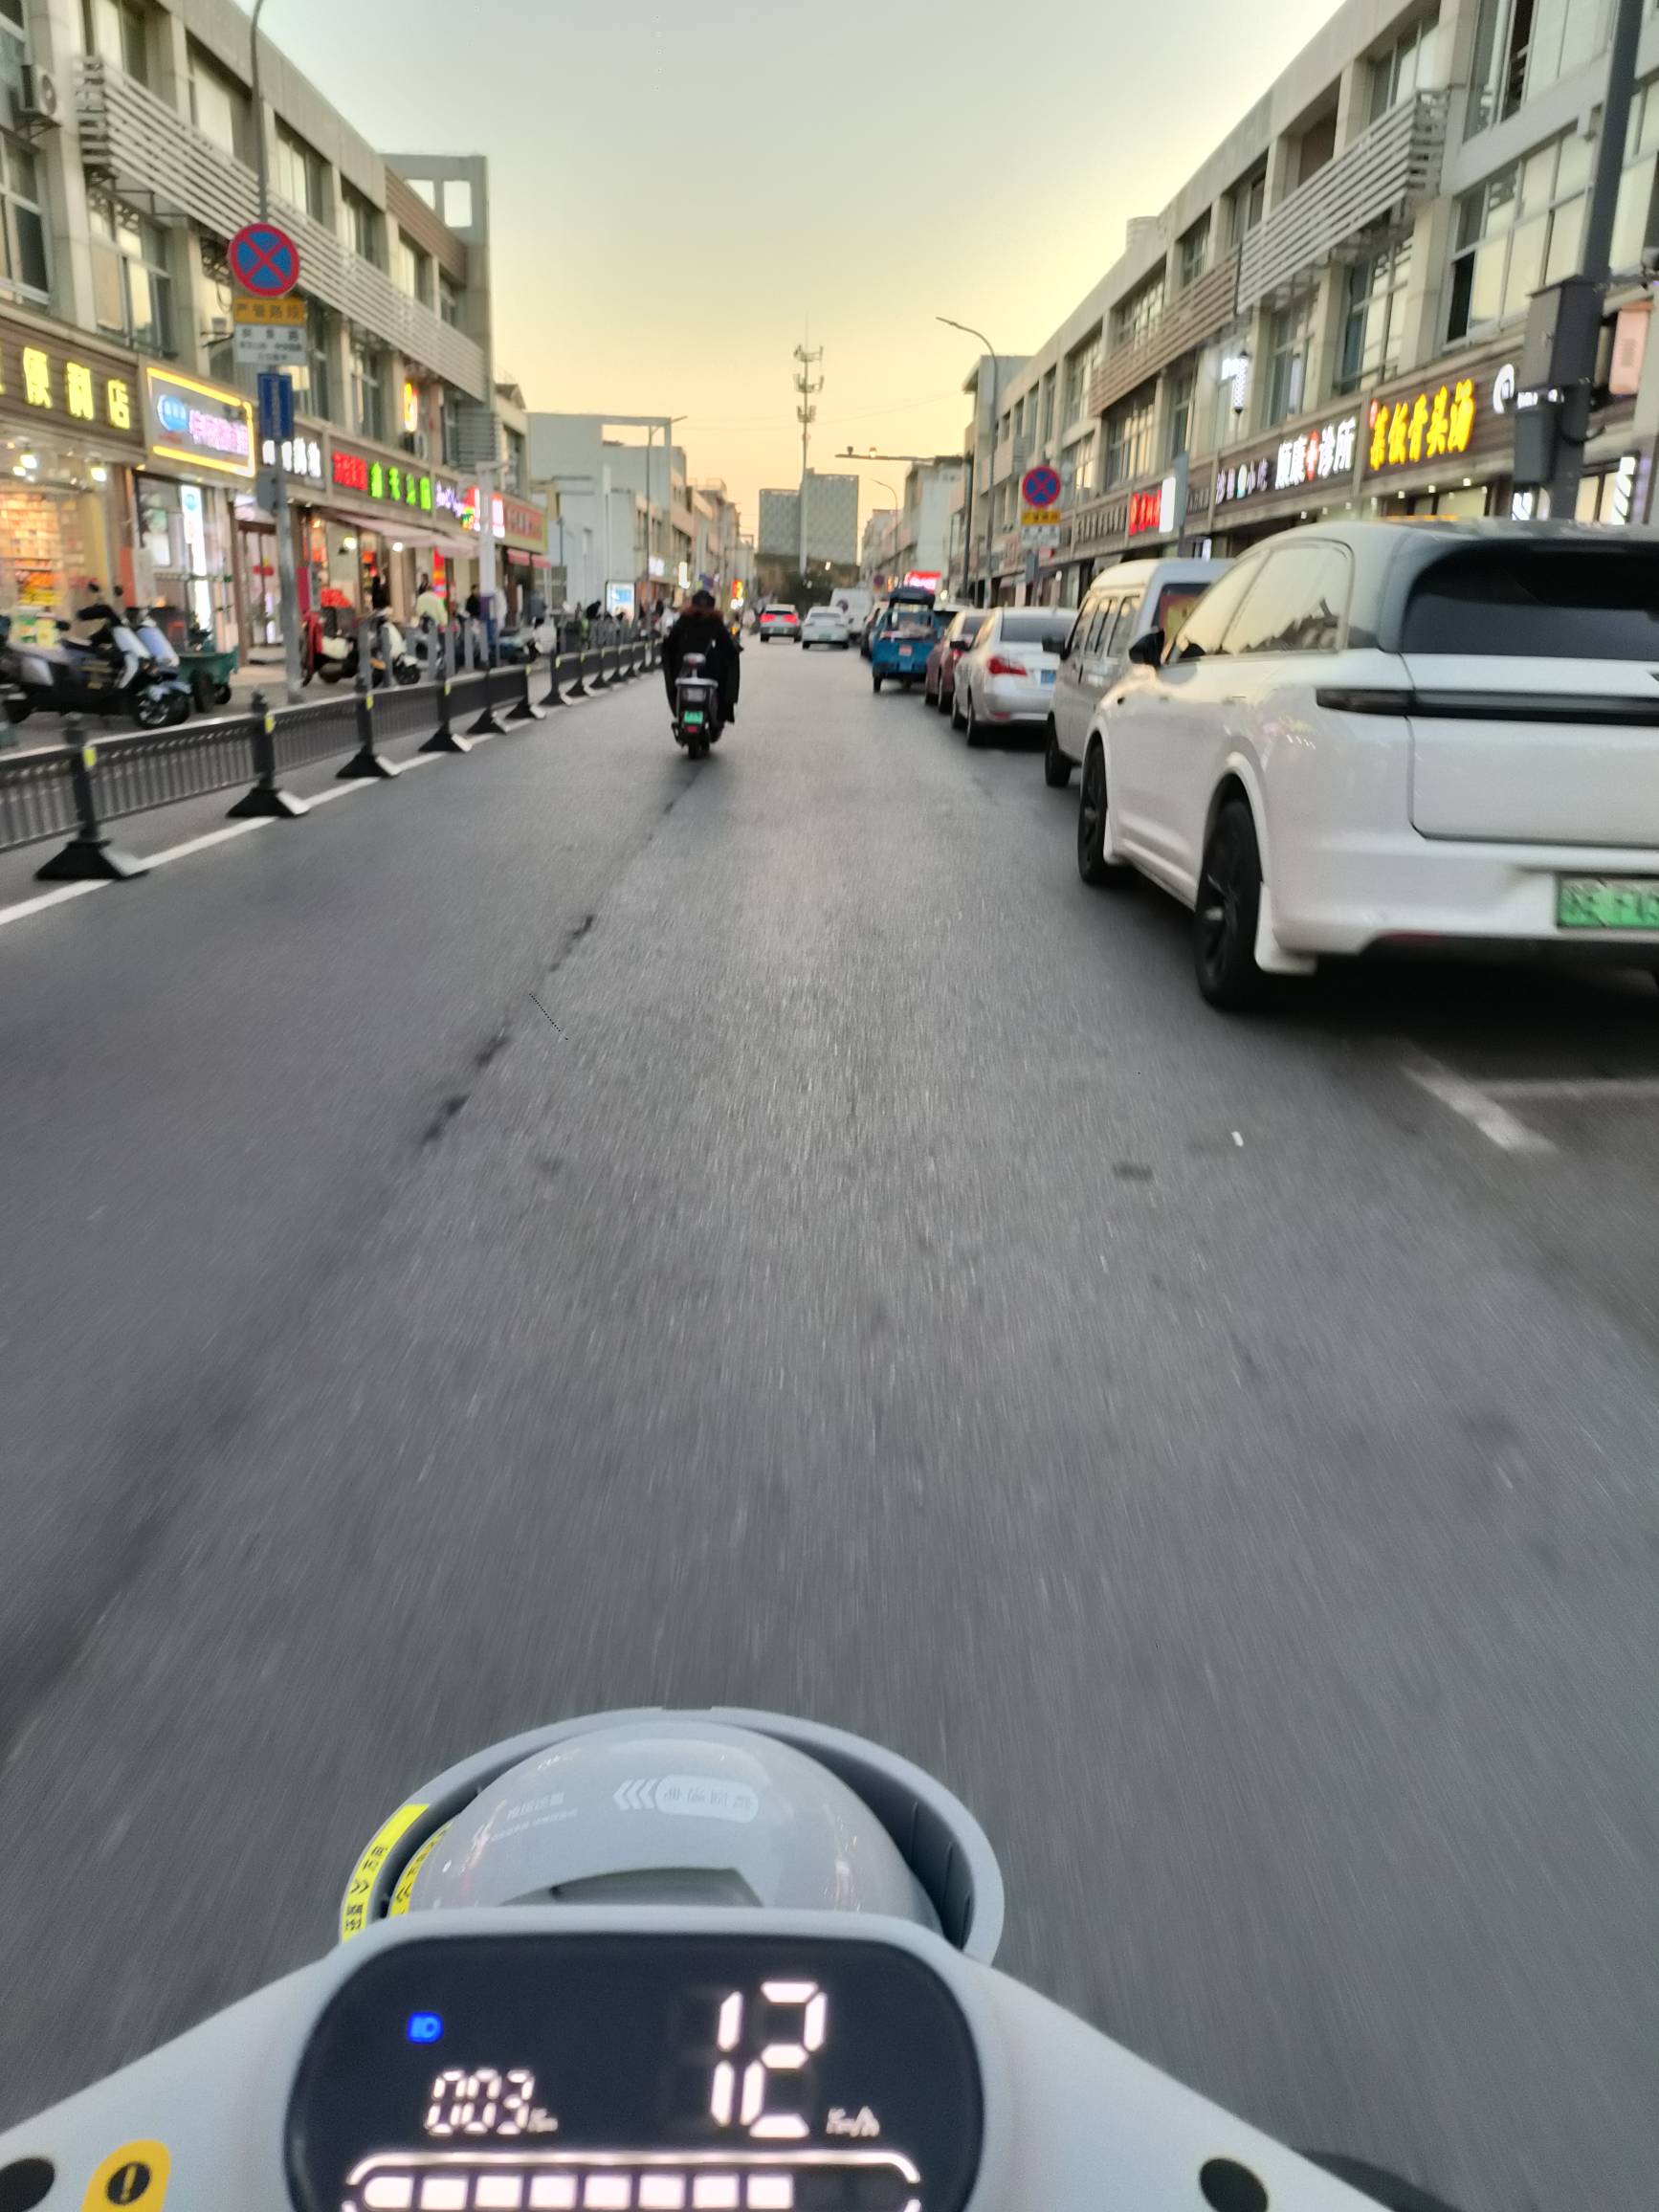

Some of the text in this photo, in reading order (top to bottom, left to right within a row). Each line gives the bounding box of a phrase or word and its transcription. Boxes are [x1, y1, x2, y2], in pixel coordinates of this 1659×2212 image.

[0, 345, 131, 430] 便利店
[710, 1980, 829, 2139] 12
[425, 2068, 536, 2137] 003
